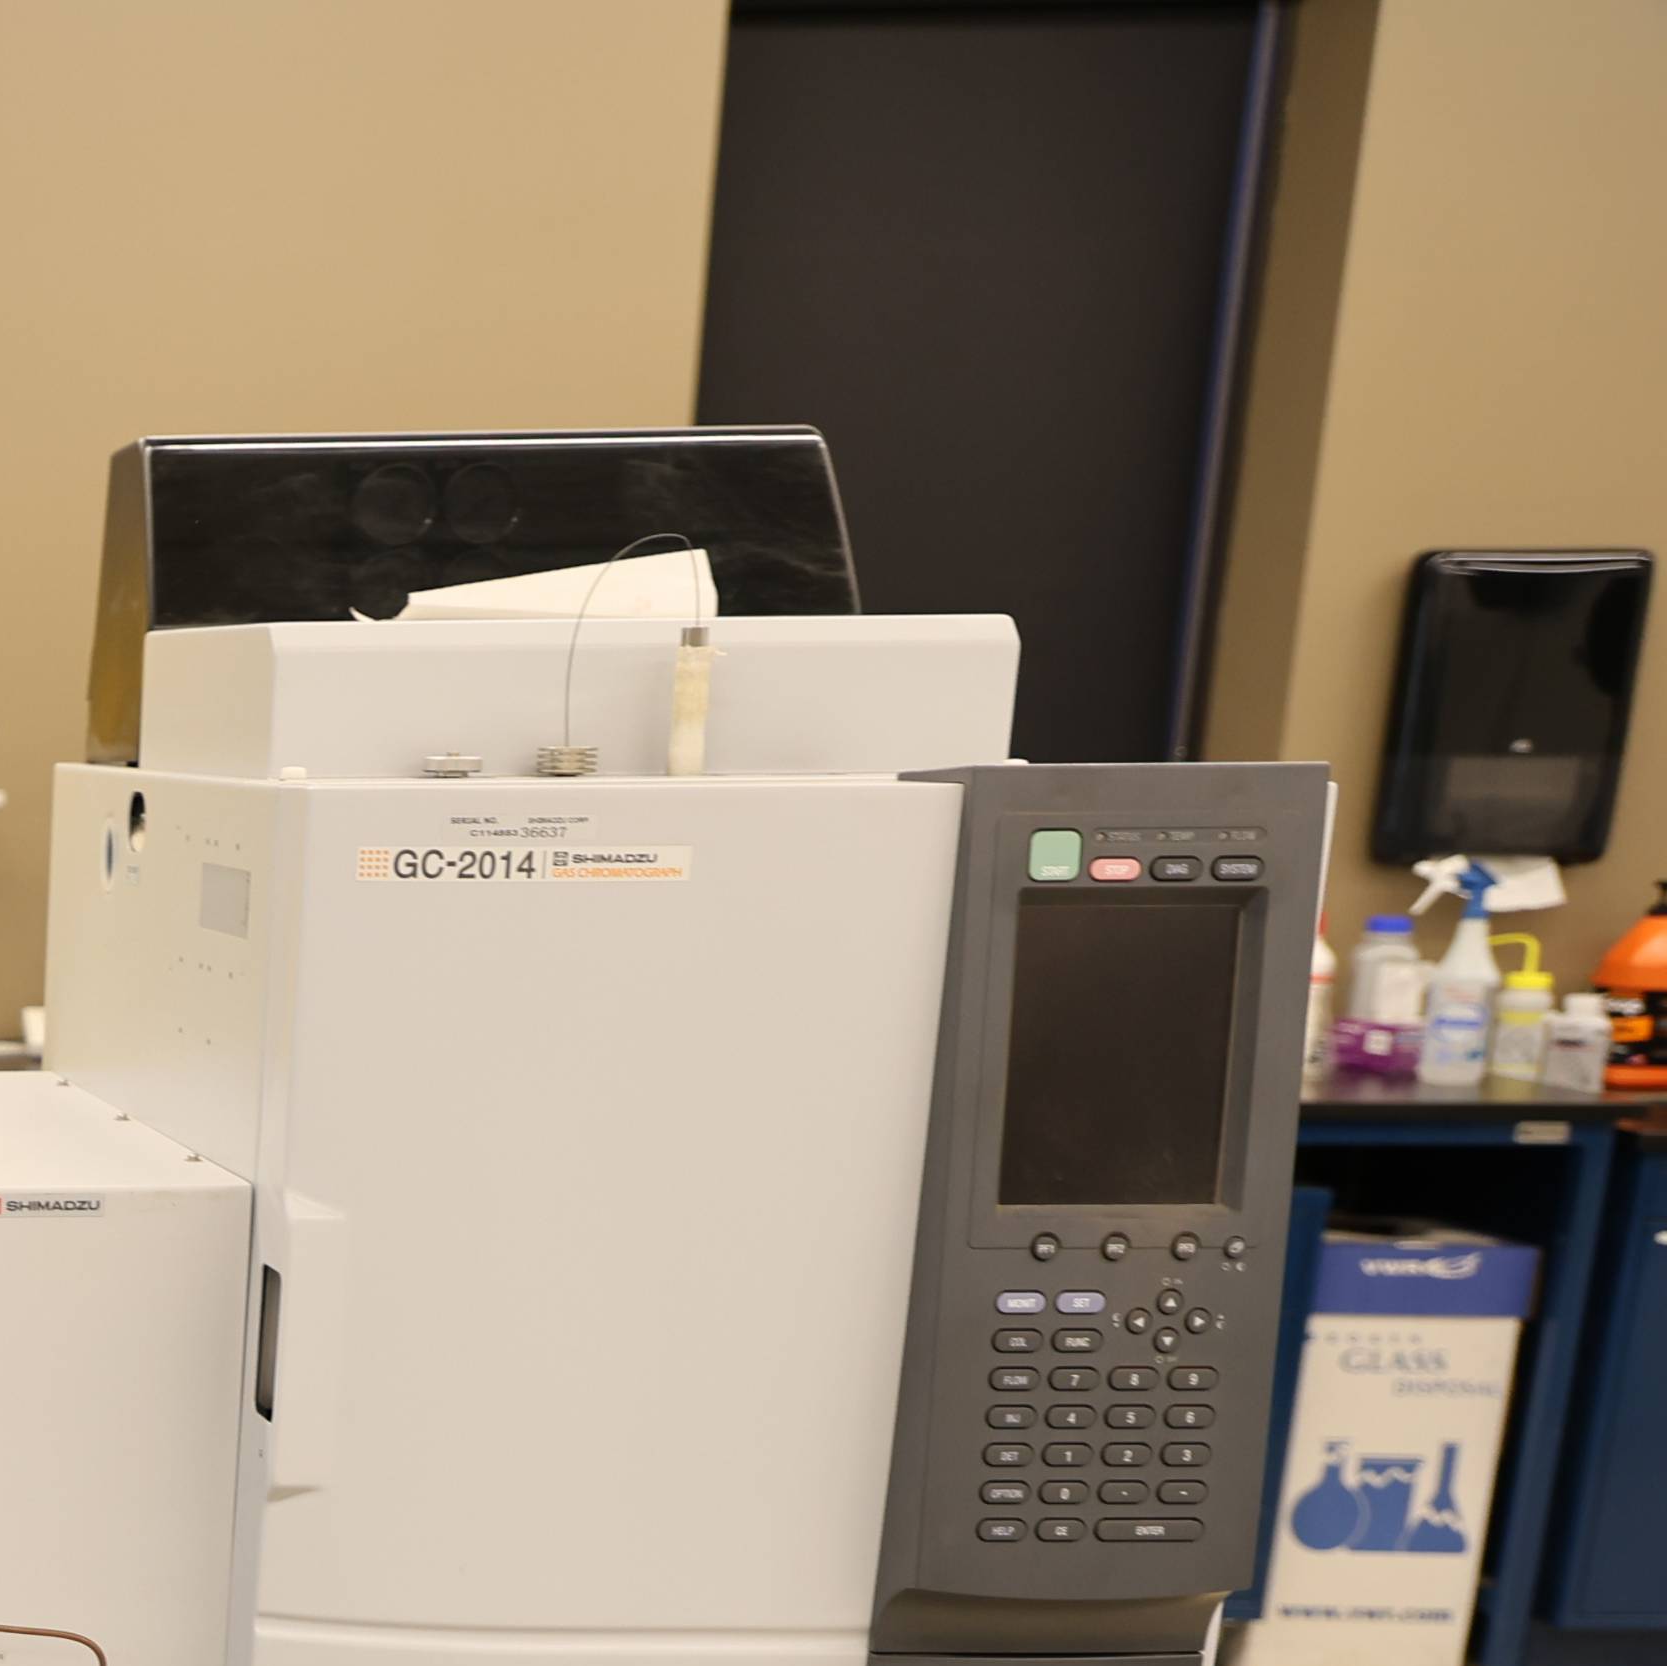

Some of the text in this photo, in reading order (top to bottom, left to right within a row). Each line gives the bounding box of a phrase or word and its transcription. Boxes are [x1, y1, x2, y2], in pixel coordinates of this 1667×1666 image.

[393, 849, 536, 880] GC-2014
[571, 853, 659, 864] SHIMADZU
[552, 867, 683, 878] GAS CHROMATOGRAPH
[1104, 864, 1130, 876] STOP
[1219, 863, 1259, 875] SYSTEM
[5, 1199, 101, 1212] SHIMADZU
[1071, 1298, 1091, 1309] SET
[1065, 1337, 1091, 1348] FUNC
[1003, 1375, 1029, 1386] FLOW
[1070, 1374, 1081, 1387] 7
[1129, 1373, 1140, 1386] 8
[1188, 1373, 1199, 1386] 9
[1066, 1412, 1077, 1425] 4
[1125, 1412, 1136, 1425] 5
[1185, 1412, 1196, 1424] 6
[1063, 1451, 1073, 1463] 1
[1122, 1450, 1134, 1463] 2
[1182, 1450, 1193, 1463] 3
[989, 1488, 1024, 1500] OPTION
[1059, 1488, 1070, 1501] 0
[991, 1525, 1016, 1537] HELP
[1134, 1525, 1166, 1537] ENTER
